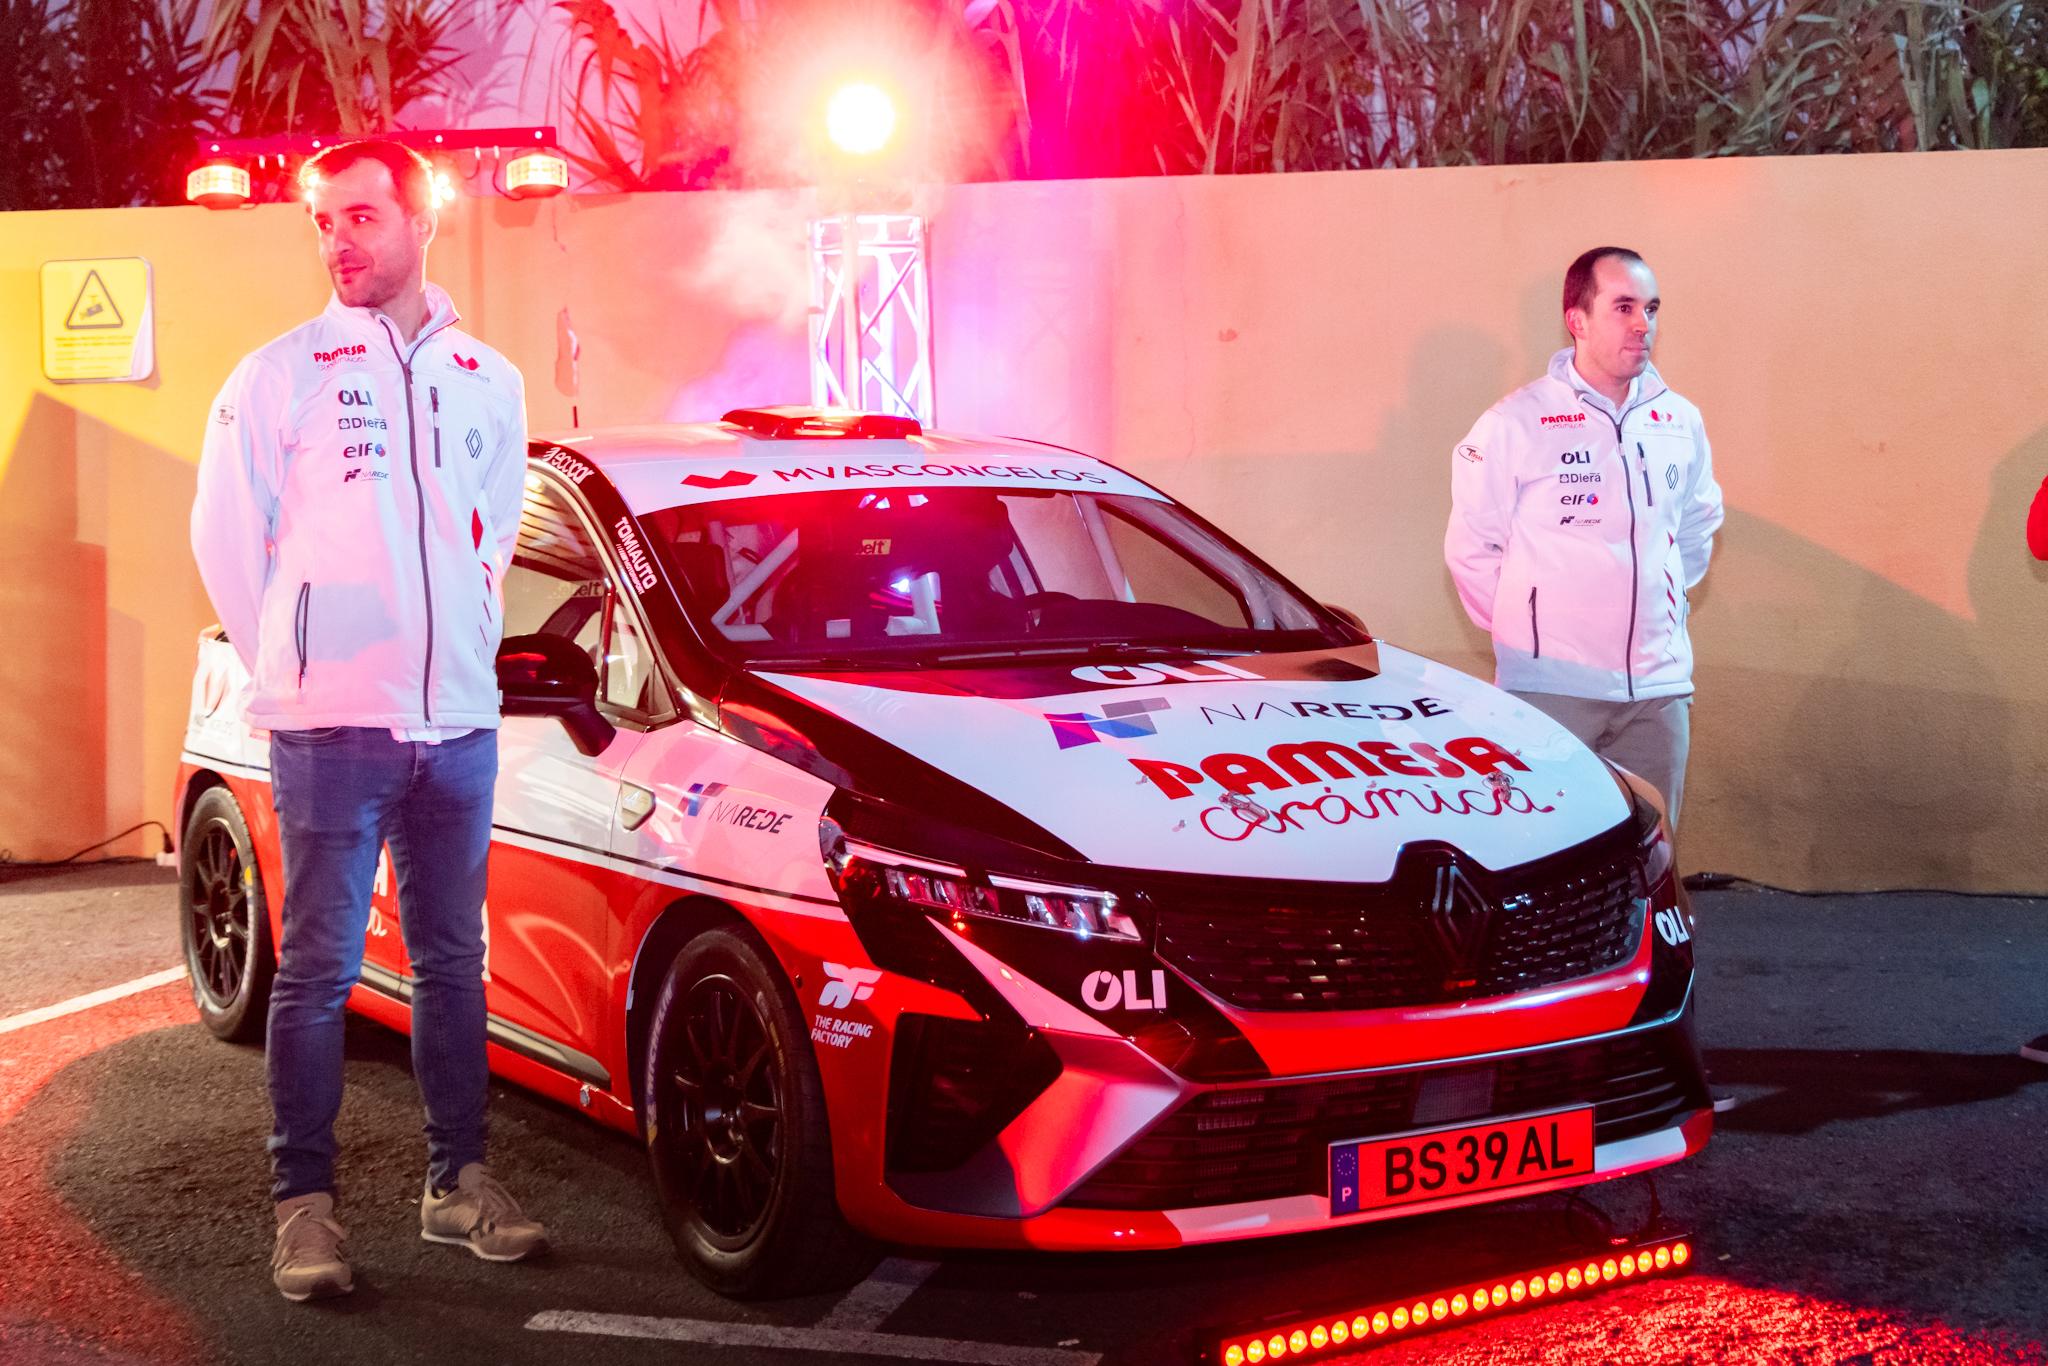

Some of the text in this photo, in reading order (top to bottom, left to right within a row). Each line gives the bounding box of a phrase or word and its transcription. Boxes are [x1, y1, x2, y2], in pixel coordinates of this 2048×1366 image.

[313, 344, 366, 362] PAMESA
[338, 389, 373, 407] OLI
[1540, 412, 1586, 425] PAMESA
[343, 442, 373, 458] elf
[1561, 450, 1591, 465] OLI
[773, 464, 1107, 484] MVASCONCELOS
[1560, 494, 1586, 506] elf
[614, 515, 658, 590] TOMIAUTO
[1070, 660, 1266, 686] OLI
[1200, 697, 1454, 725] NAREDE
[1127, 736, 1533, 800] PAMESA
[708, 800, 793, 834] NAREDE
[1655, 905, 1690, 946] OLI
[1081, 969, 1167, 1011] OLI
[815, 1014, 873, 1038] THE RACING
[810, 1027, 853, 1049] FACTORY
[1384, 1122, 1575, 1197] BS 39 AL
[1341, 1186, 1353, 1202] P
